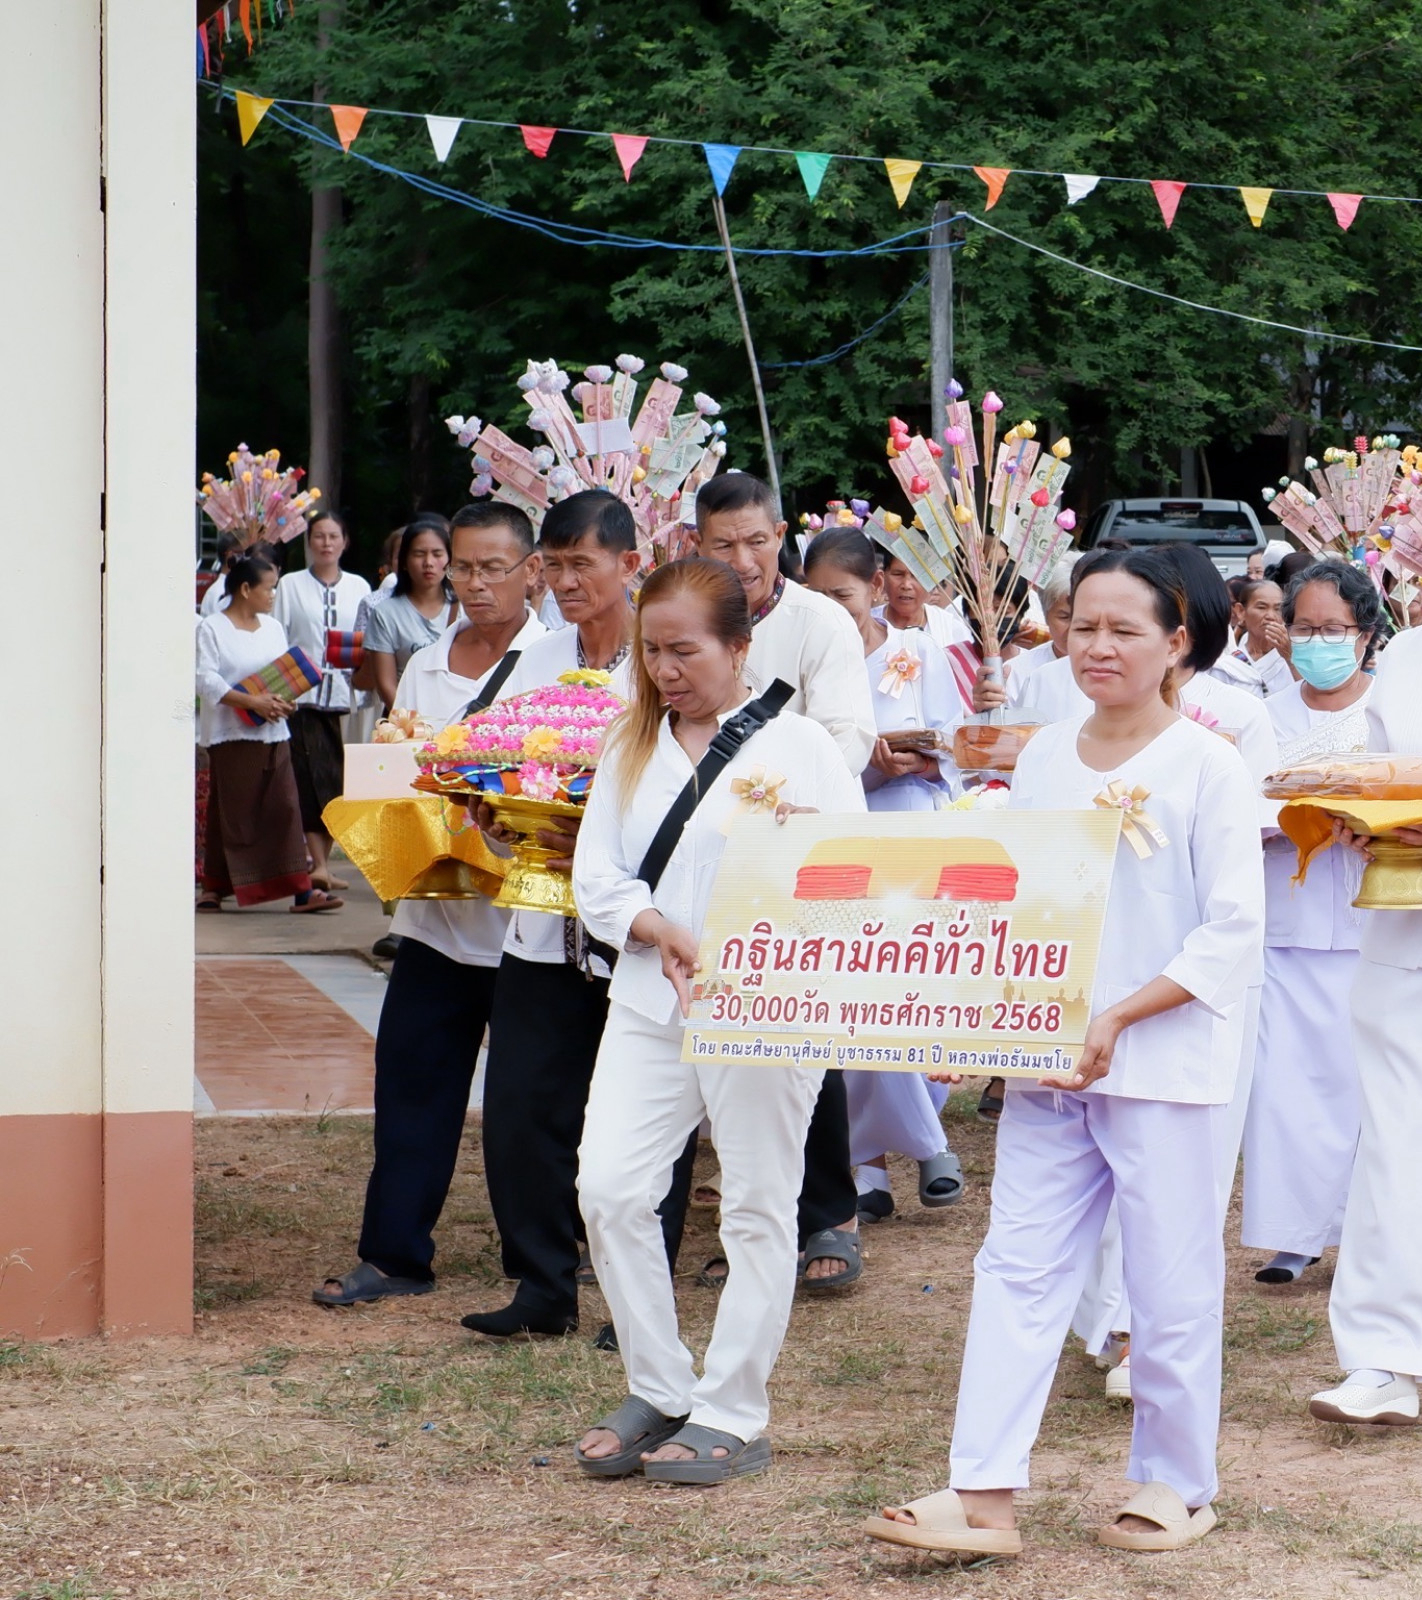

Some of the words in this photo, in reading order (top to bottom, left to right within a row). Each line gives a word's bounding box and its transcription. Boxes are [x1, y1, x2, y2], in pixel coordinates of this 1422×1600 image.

[721, 909, 1069, 987] กฐินสามัคคีทั่วไทย
[711, 989, 830, 1027] 30,000วัด
[839, 992, 983, 1037] พุทธศักราช
[991, 1002, 1062, 1032] 2568
[692, 1034, 716, 1055] โดย
[721, 1038, 833, 1064] คณะศิษยานุศิษย์
[836, 1047, 902, 1066] บูชาธรรม
[907, 1047, 925, 1063] 81
[931, 1044, 943, 1064] ปี
[948, 1045, 1072, 1070] หลวงพ่อธัมมชโย
